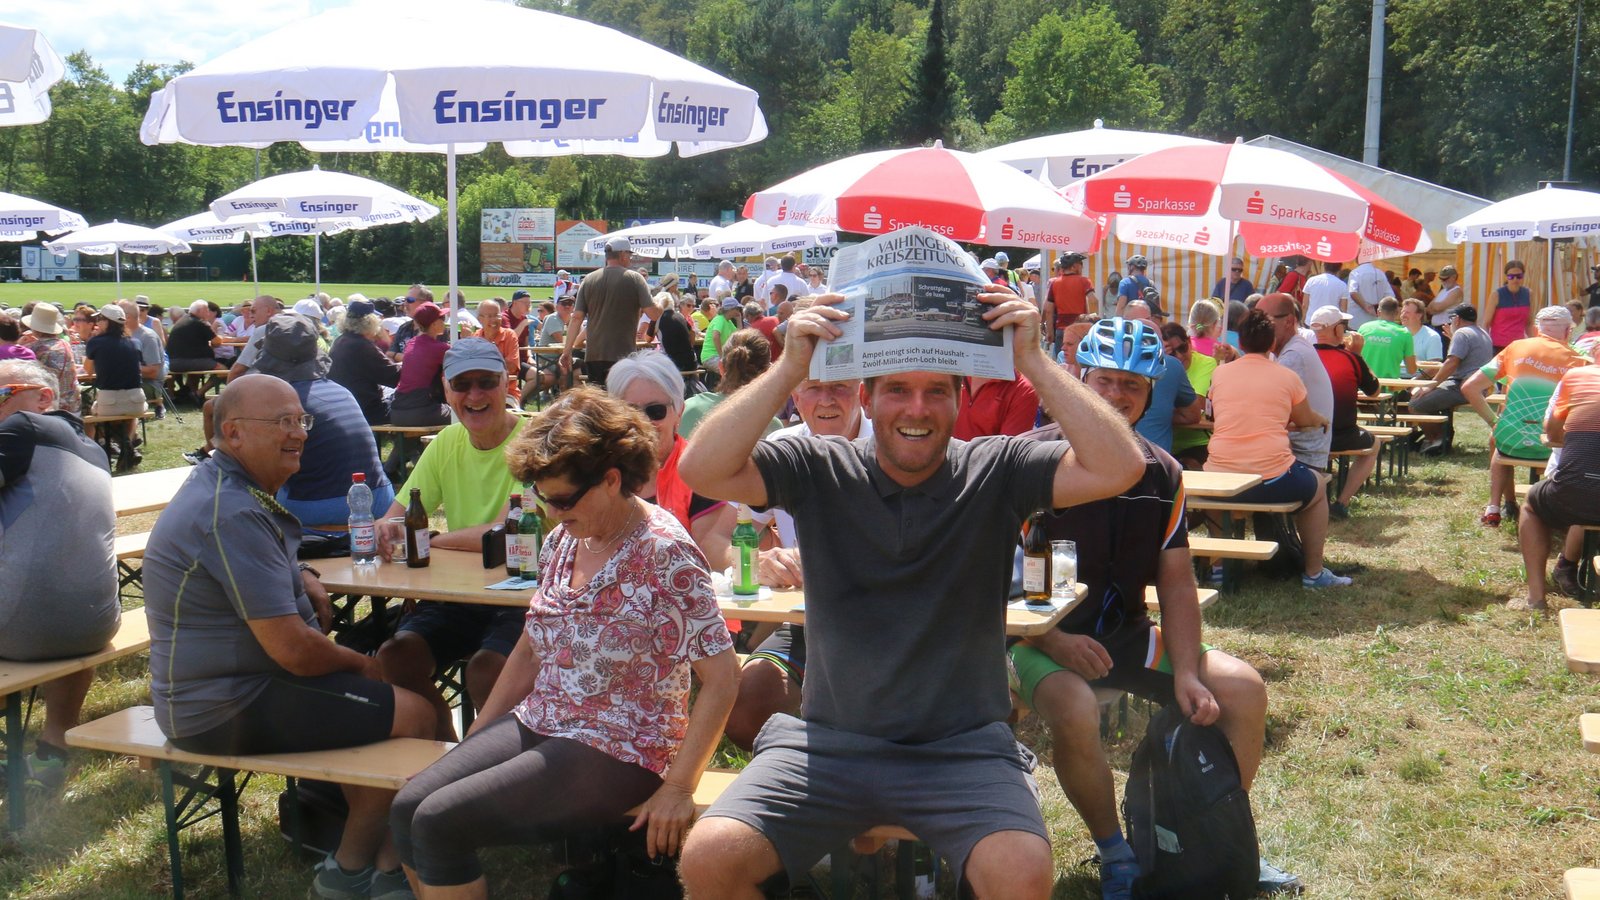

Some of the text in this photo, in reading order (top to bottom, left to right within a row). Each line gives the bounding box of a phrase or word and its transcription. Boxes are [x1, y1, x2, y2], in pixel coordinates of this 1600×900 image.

[217, 90, 357, 129] Ensinger
[433, 90, 607, 129] Ensinger
[658, 92, 730, 133] Ensinger
[231, 201, 278, 210] Ensinger
[300, 201, 358, 213] Ensinger
[1137, 197, 1196, 212] Sparkasse
[1270, 204, 1337, 224] Sparkasse
[0, 215, 45, 227] nsinger
[269, 221, 316, 232] Ensing
[1550, 221, 1600, 233] Ensinge
[1018, 229, 1070, 245] Sparkasse
[1373, 225, 1400, 245] Sparkasse
[1481, 227, 1527, 238] Ensinger
[628, 236, 676, 246] Ensinger
[771, 240, 806, 250] Ensinger
[878, 234, 956, 254] VAIHINGER
[720, 246, 755, 255] Ensinger
[867, 248, 966, 269] KREISZEITUNG
[862, 350, 884, 360] Ampel
[885, 347, 905, 358] einigt
[906, 347, 919, 355] sich
[922, 347, 933, 355] auf
[934, 348, 964, 358] Haushalt
[937, 357, 957, 366] bleibt
